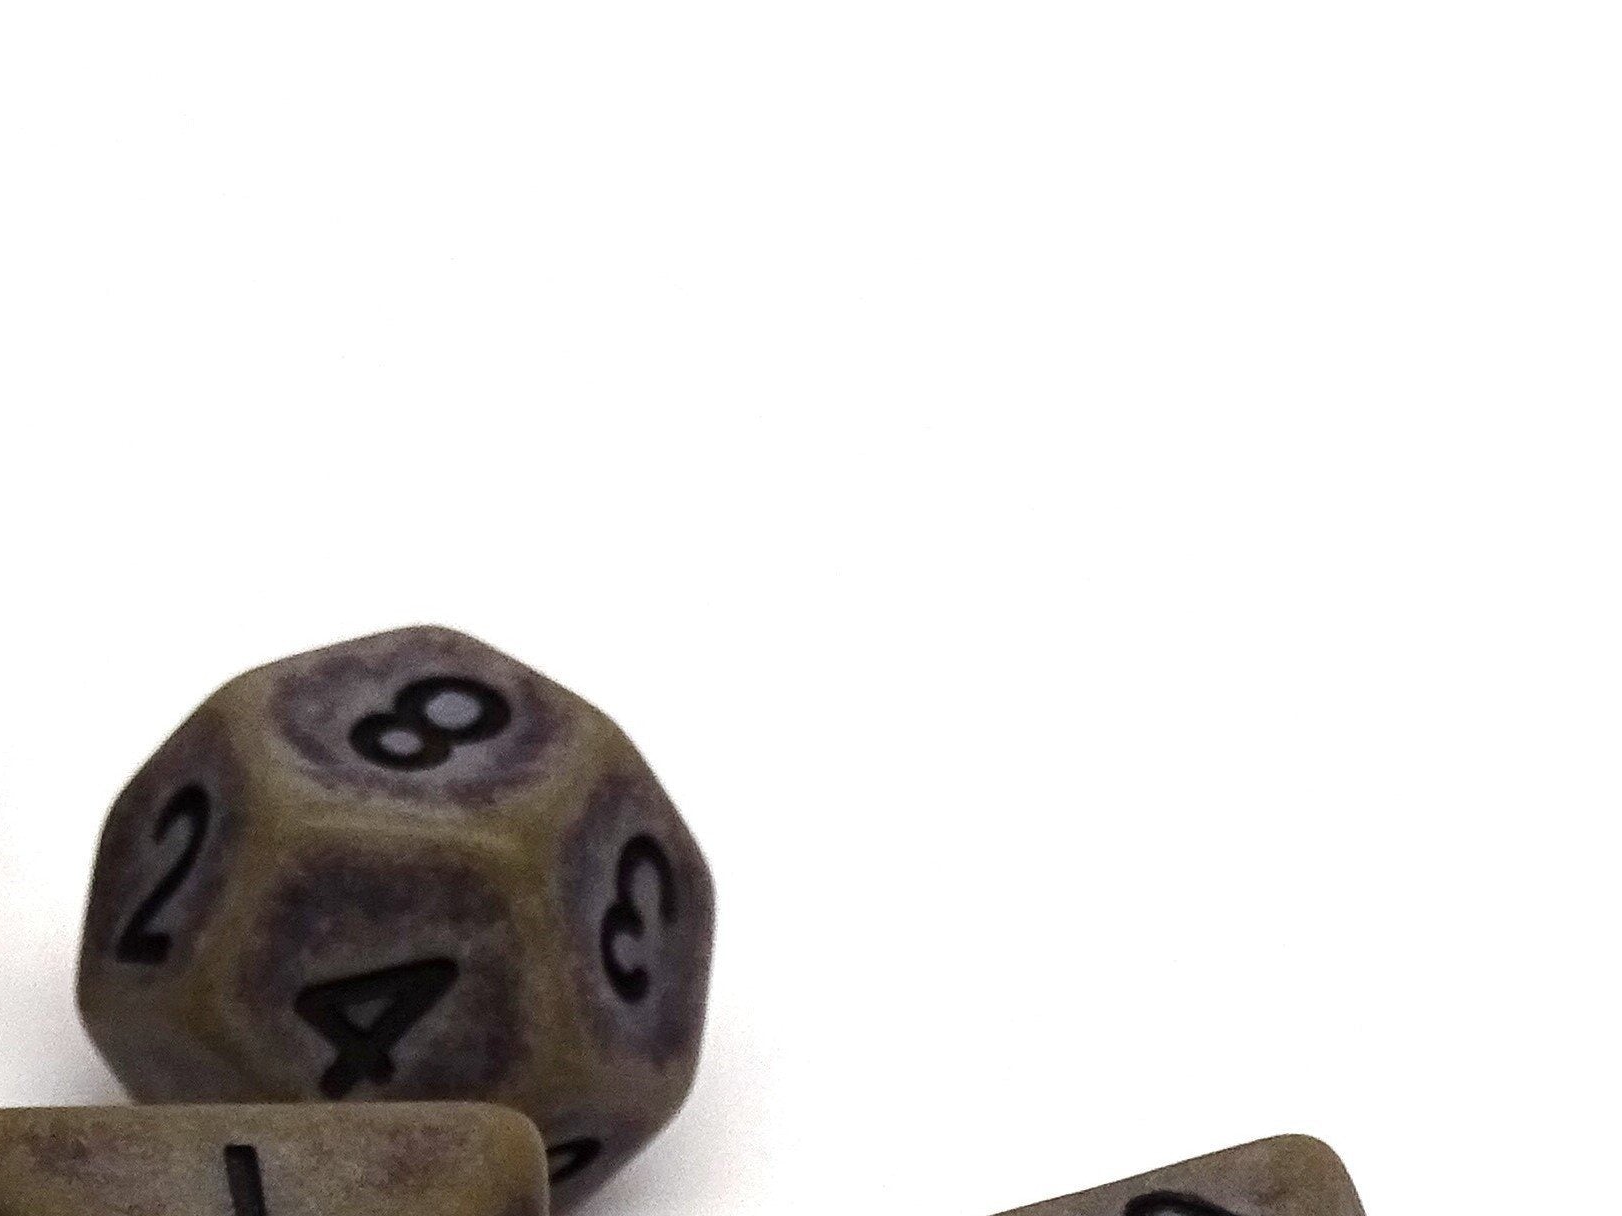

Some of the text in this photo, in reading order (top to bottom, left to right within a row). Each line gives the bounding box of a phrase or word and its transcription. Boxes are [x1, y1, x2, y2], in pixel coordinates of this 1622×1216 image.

[348, 674, 512, 773] 8
[115, 783, 212, 965] 2
[600, 832, 676, 1005] 3
[292, 956, 460, 1102] 4
